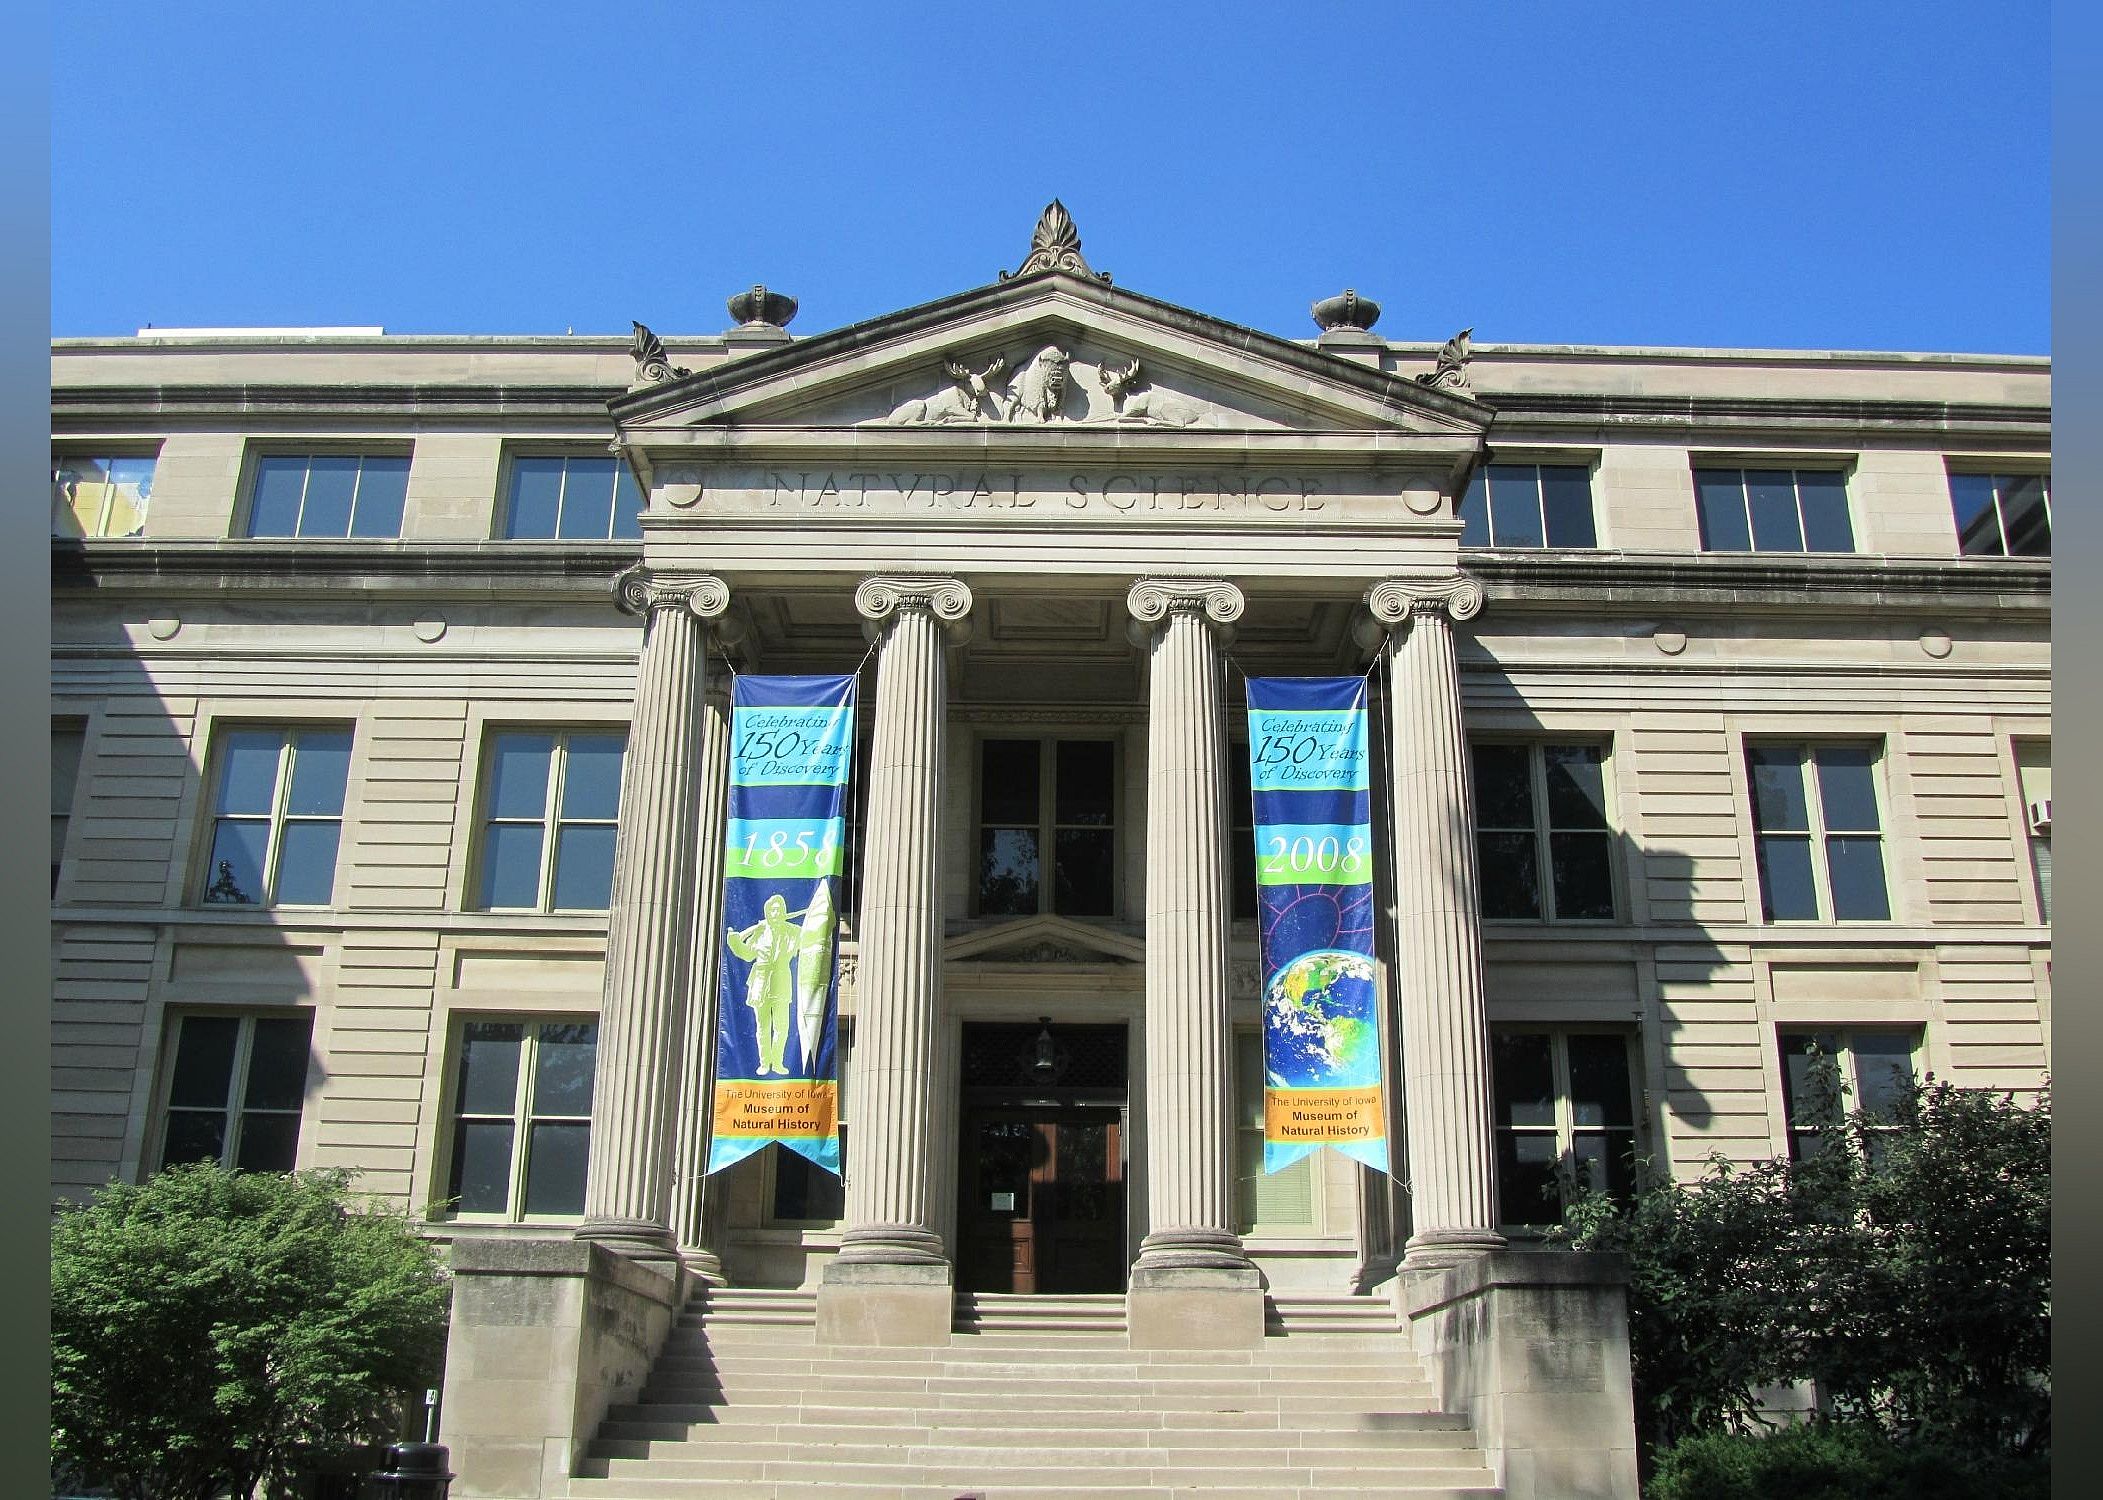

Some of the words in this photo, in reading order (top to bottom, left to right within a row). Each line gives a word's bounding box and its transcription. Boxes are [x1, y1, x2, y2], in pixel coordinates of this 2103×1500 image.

[769, 471, 1037, 510] NATVRAL
[1065, 474, 1326, 513] SCIENCE
[1261, 718, 1355, 736] Celebrating
[733, 731, 801, 763] 150
[801, 739, 851, 757] Years
[1253, 735, 1318, 767] 150
[1318, 743, 1365, 761] Years
[738, 762, 759, 777] of
[760, 760, 841, 779] Discovery
[1259, 765, 1278, 781] of
[1281, 764, 1360, 783] Discovery
[738, 831, 838, 869] 1858
[1263, 836, 1364, 874] 2008
[725, 1089, 743, 1099] The
[744, 1090, 792, 1100] University
[794, 1089, 806, 1099] of
[1271, 1097, 1290, 1107] The
[1292, 1096, 1341, 1108] University
[1342, 1096, 1354, 1106] of
[1355, 1096, 1377, 1105] Iowa
[743, 1103, 794, 1113] Museum
[797, 1103, 810, 1114] of
[1292, 1111, 1343, 1121] Museum
[1346, 1110, 1359, 1120] of
[732, 1119, 774, 1130] Natural
[777, 1119, 821, 1132] History
[1281, 1126, 1324, 1136] Natural
[1327, 1125, 1370, 1137] History
